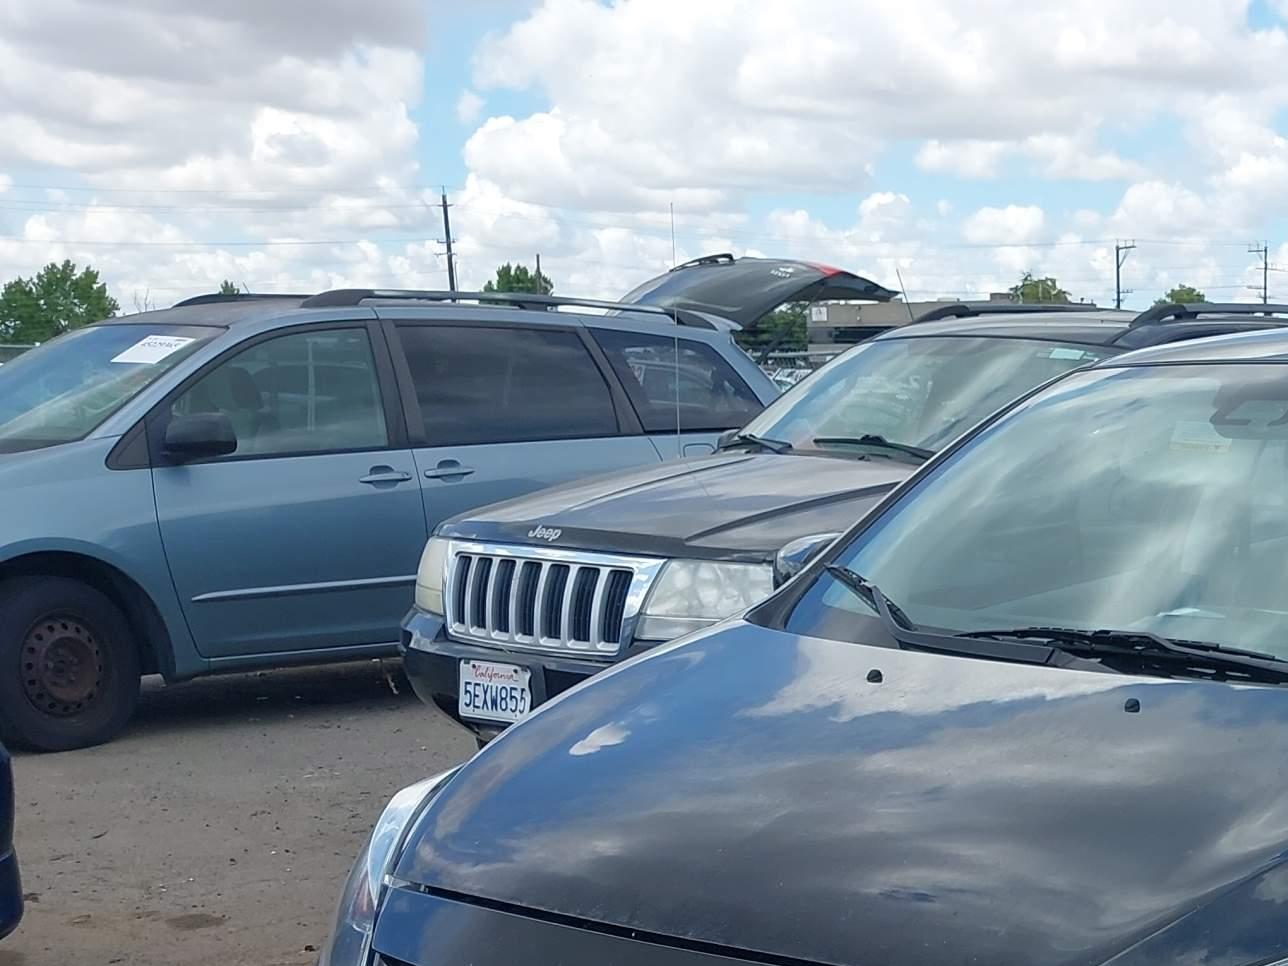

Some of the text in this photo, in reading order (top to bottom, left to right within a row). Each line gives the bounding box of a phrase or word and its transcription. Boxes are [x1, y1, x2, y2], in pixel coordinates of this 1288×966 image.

[528, 525, 562, 542] Jeep
[474, 665, 514, 682] California
[463, 681, 526, 714] 5EXW855
